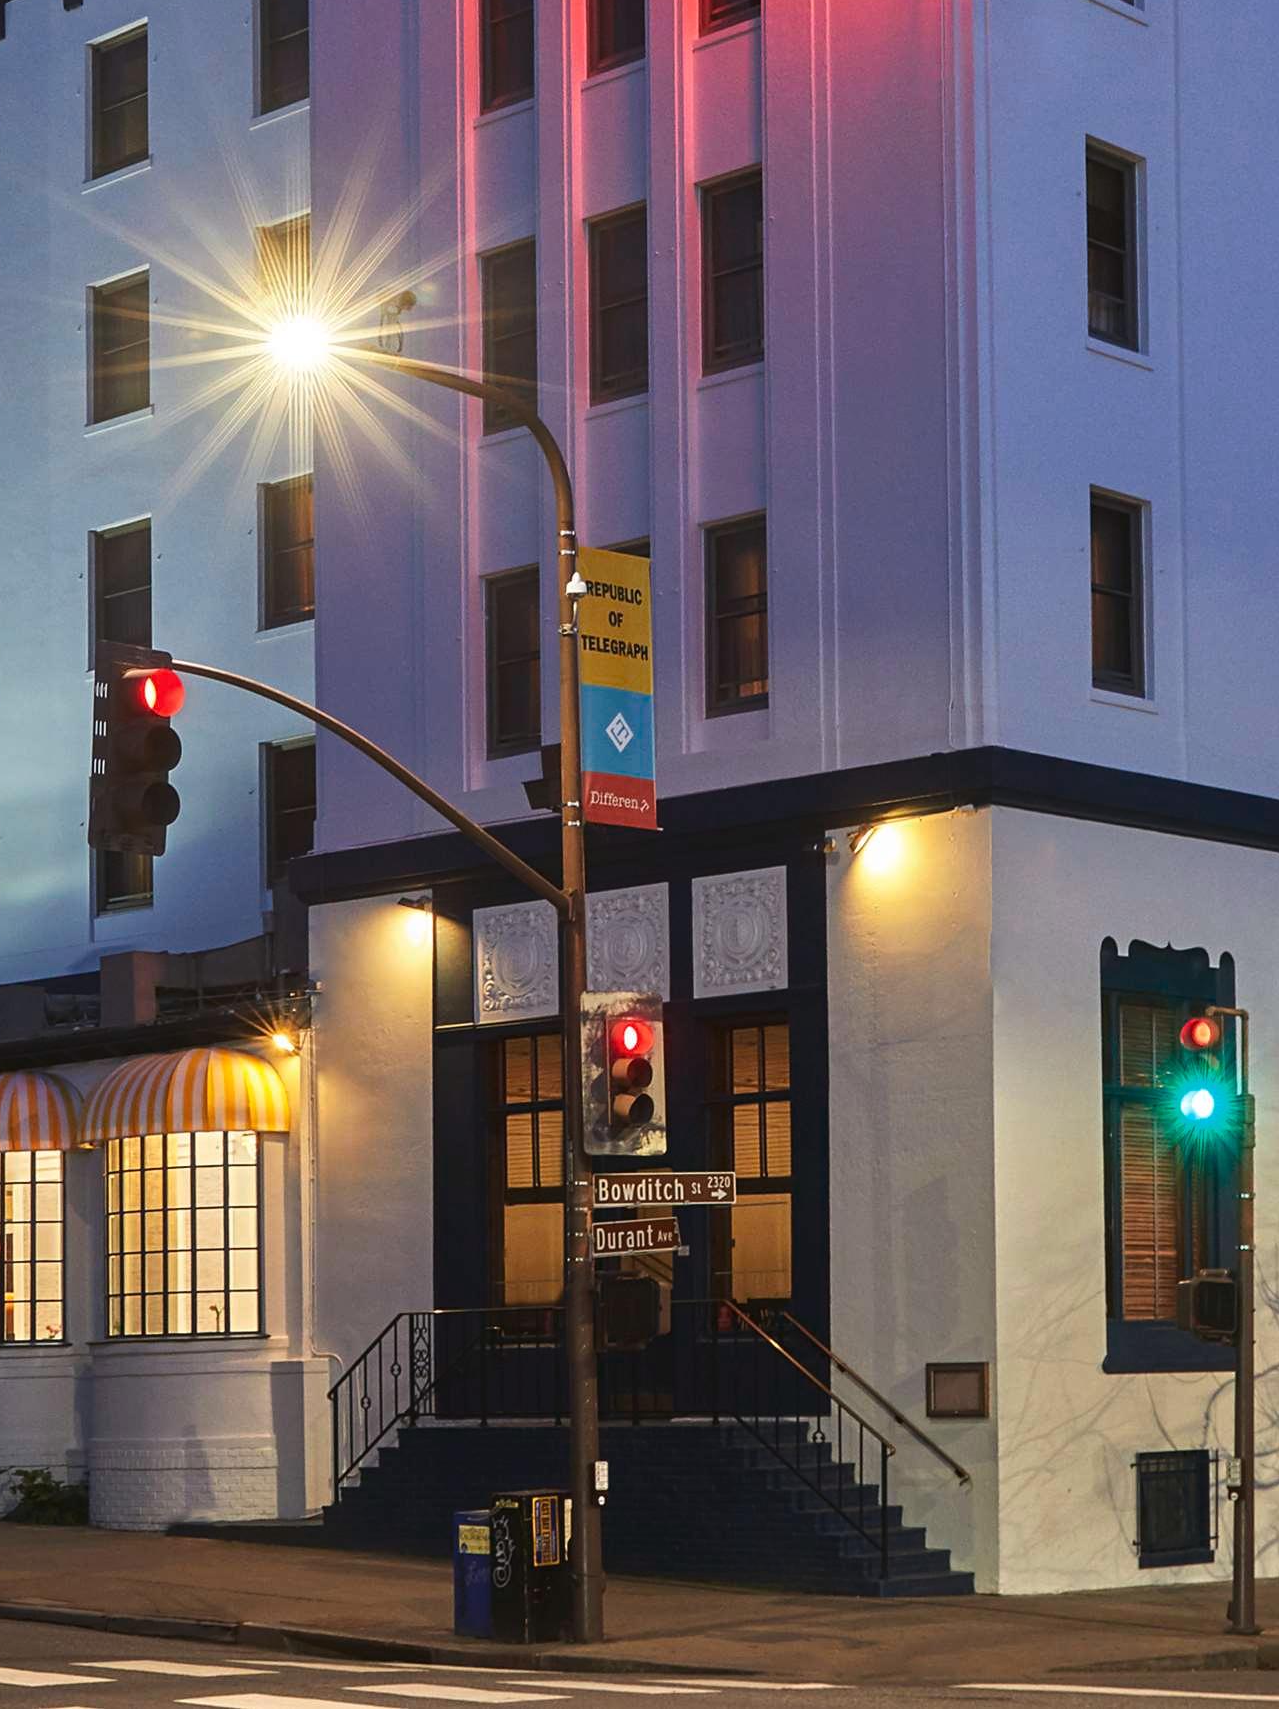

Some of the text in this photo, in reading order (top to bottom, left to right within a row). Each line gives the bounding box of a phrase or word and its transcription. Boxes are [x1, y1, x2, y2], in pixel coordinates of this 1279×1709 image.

[585, 580, 643, 606] REPUBLIC
[608, 610, 624, 628] OF
[581, 634, 649, 661] TELEGRAPH
[598, 1175, 731, 1202] Bowditch St 2320
[596, 1224, 654, 1251] Durant
[657, 1230, 673, 1243] Ave
